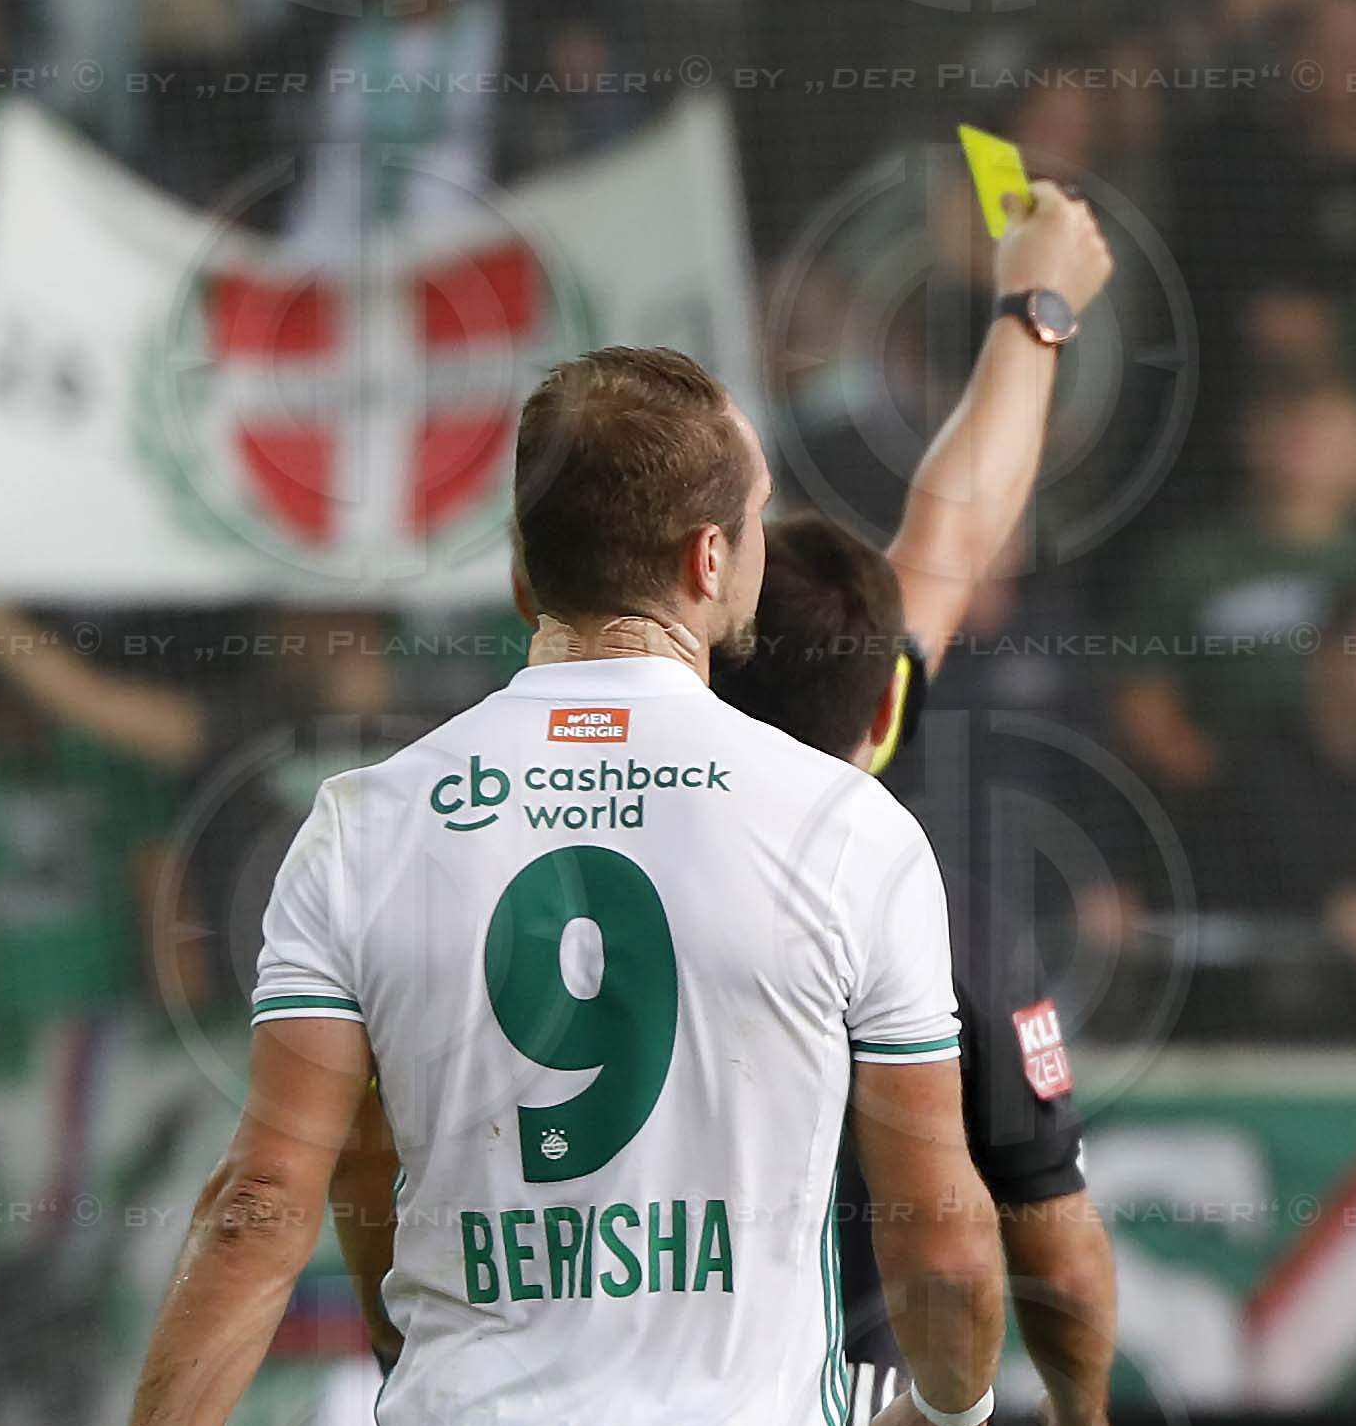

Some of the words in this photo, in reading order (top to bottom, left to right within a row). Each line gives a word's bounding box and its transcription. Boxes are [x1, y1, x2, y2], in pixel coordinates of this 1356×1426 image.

[552, 725, 624, 738] ENERGIE
[567, 713, 612, 725] WIEN
[524, 759, 732, 792] cashback
[524, 795, 644, 829] world
[485, 845, 679, 1183] 9
[460, 1199, 734, 1304] BERISHA
